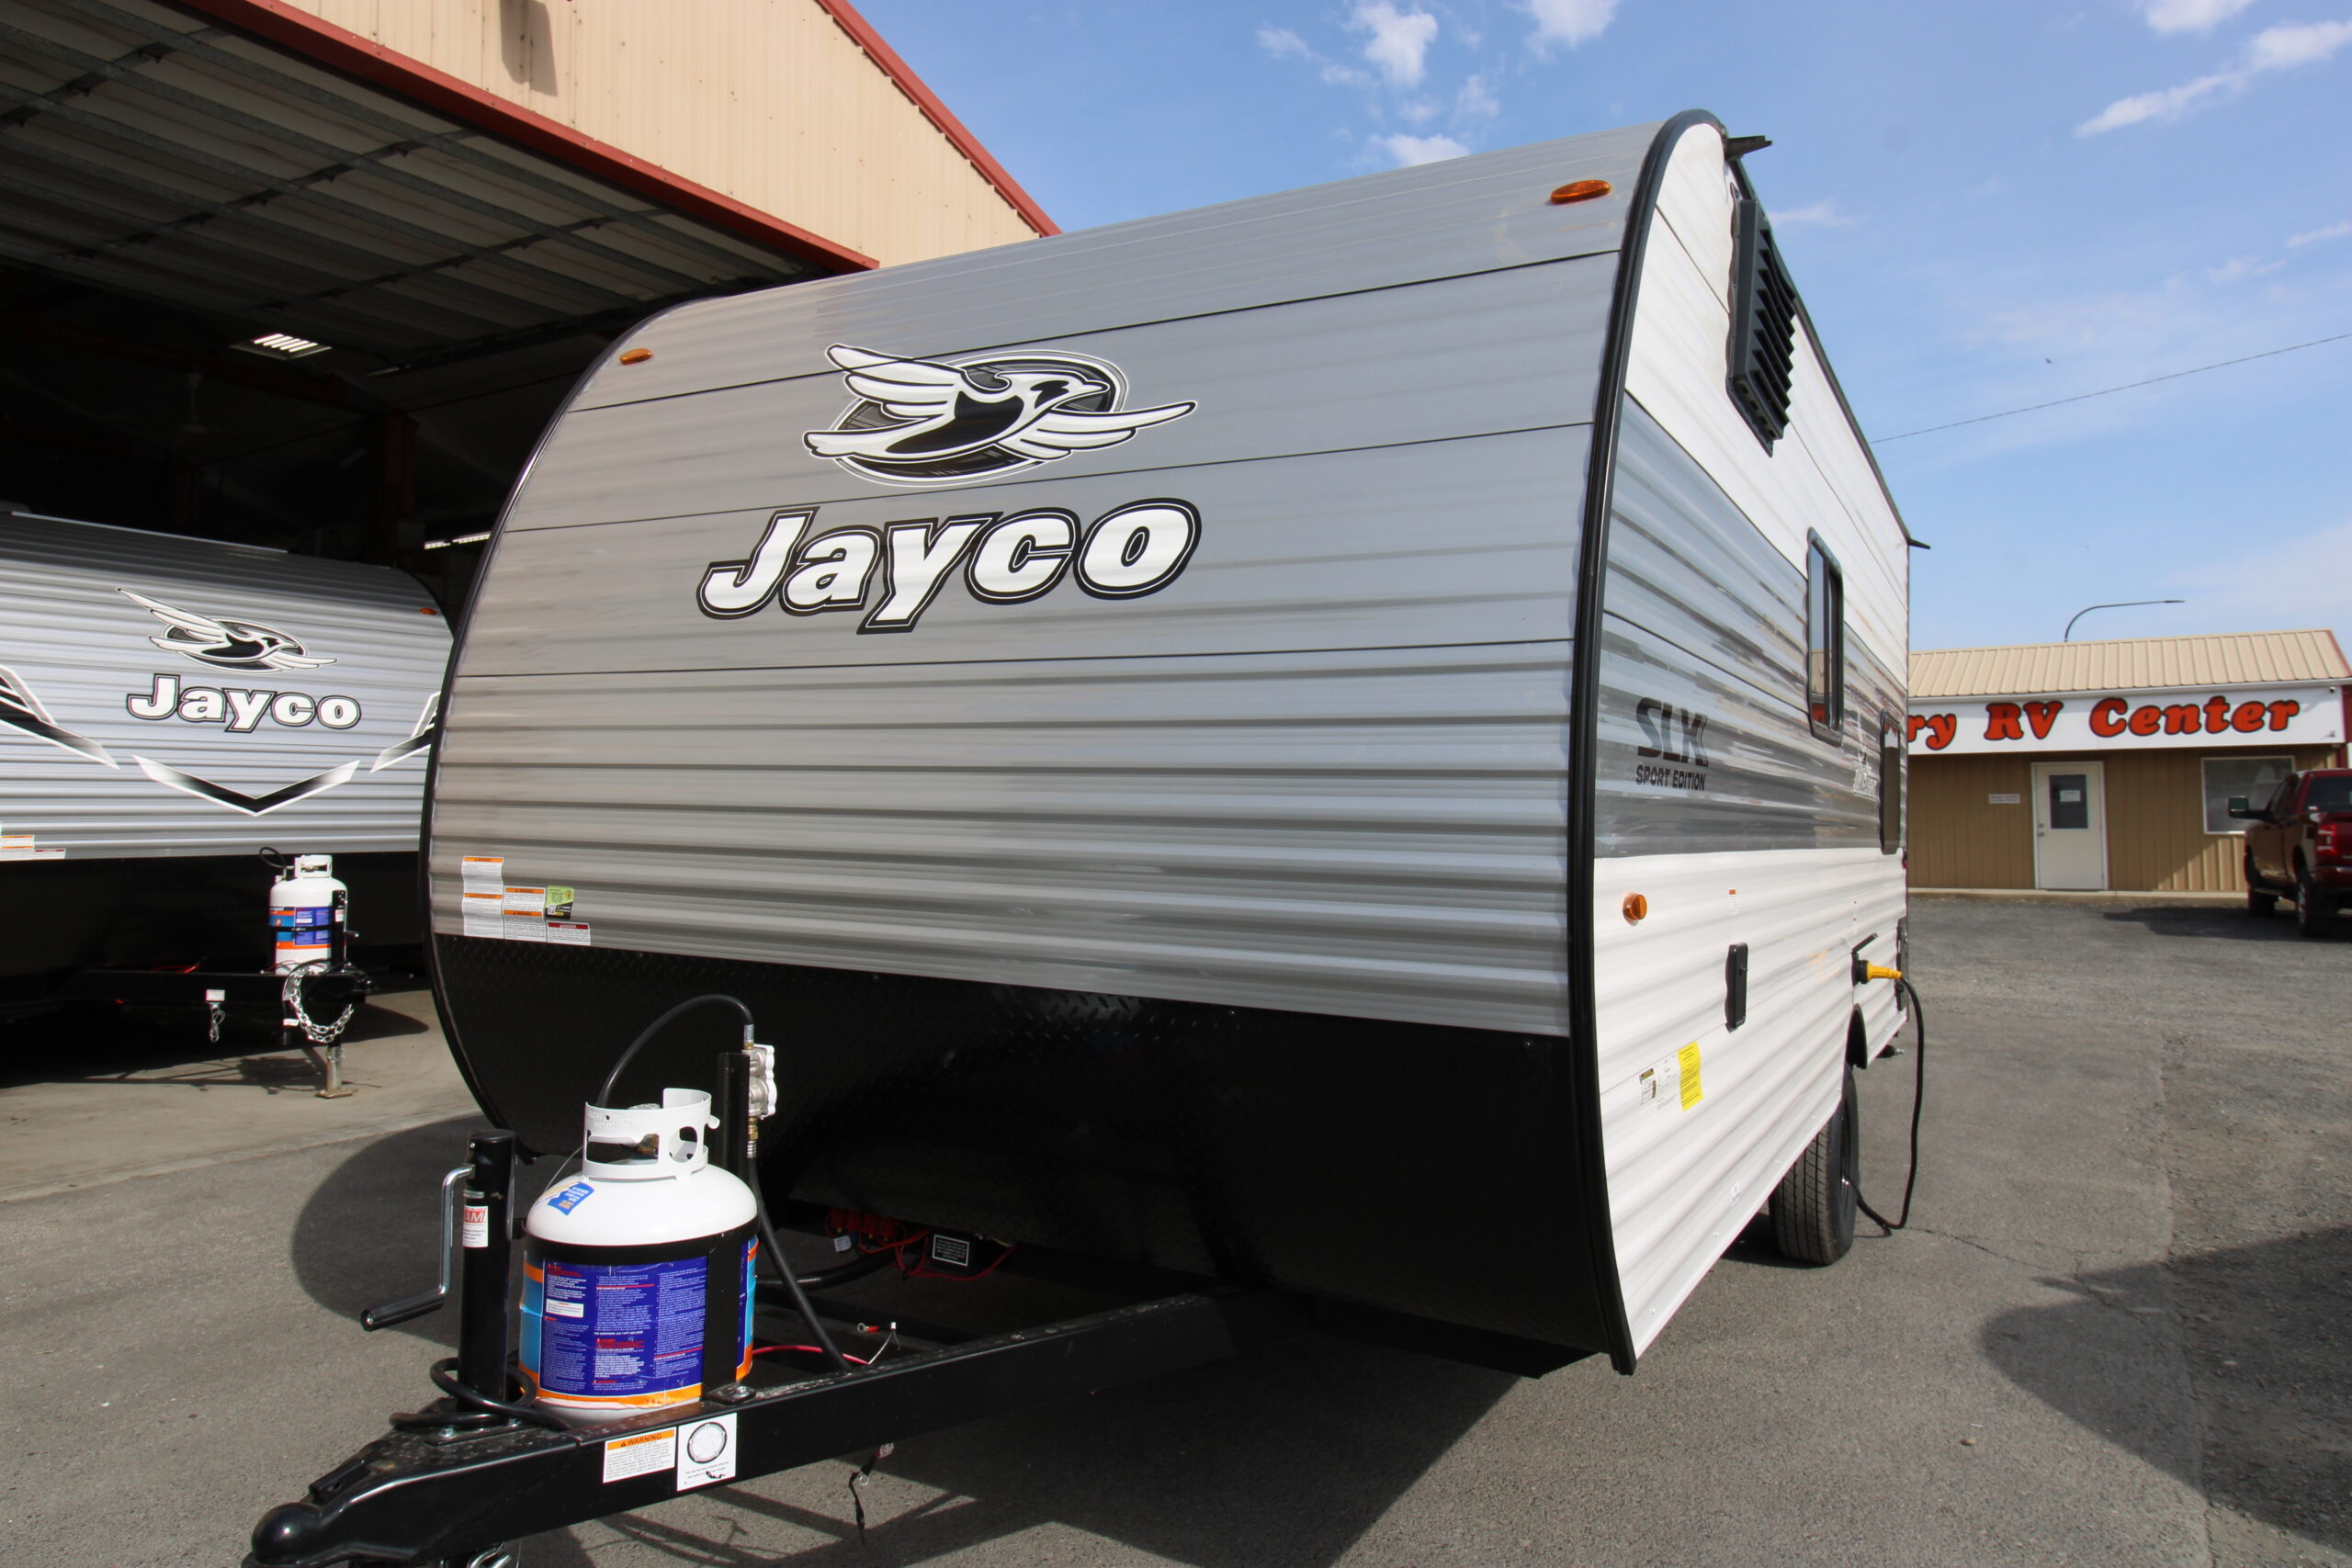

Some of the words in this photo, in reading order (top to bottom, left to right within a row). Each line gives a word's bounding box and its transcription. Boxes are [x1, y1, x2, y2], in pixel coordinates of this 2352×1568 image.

[696, 498, 1202, 635] Jayco
[127, 673, 361, 732] Jayco
[1984, 700, 2064, 740] RV
[2089, 695, 2300, 738] Center
[1635, 764, 1670, 786] SPORT
[1672, 770, 1706, 791] EDITION
[628, 1433, 662, 1447] WARNING
